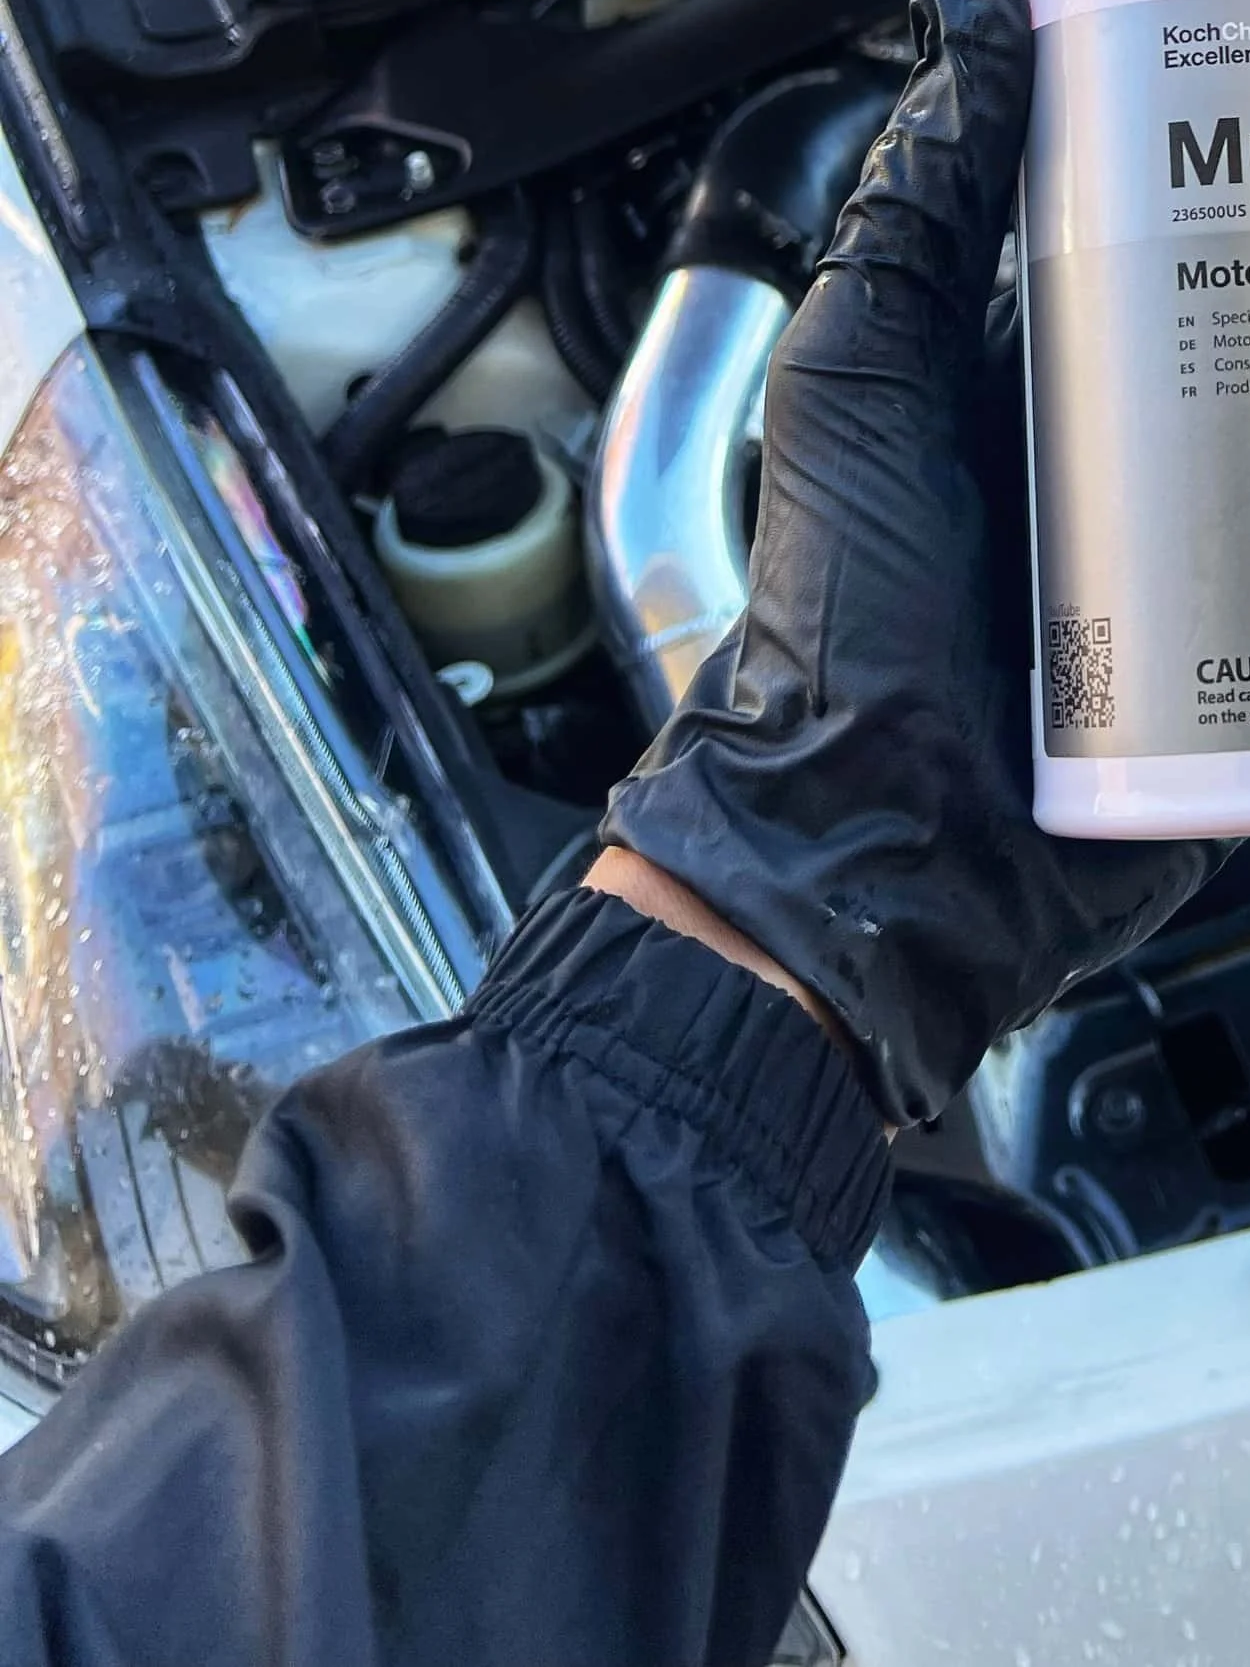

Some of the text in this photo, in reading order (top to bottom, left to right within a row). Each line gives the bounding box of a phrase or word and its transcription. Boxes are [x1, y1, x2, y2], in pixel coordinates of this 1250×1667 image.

[1172, 204, 1247, 222] 236500US
[1178, 316, 1195, 328] EN
[1179, 339, 1197, 351] DE
[1180, 362, 1196, 374] ES
[1181, 385, 1198, 398] FR
[1198, 688, 1236, 705] Read
[1198, 712, 1219, 725] on
[1221, 709, 1247, 723] the
